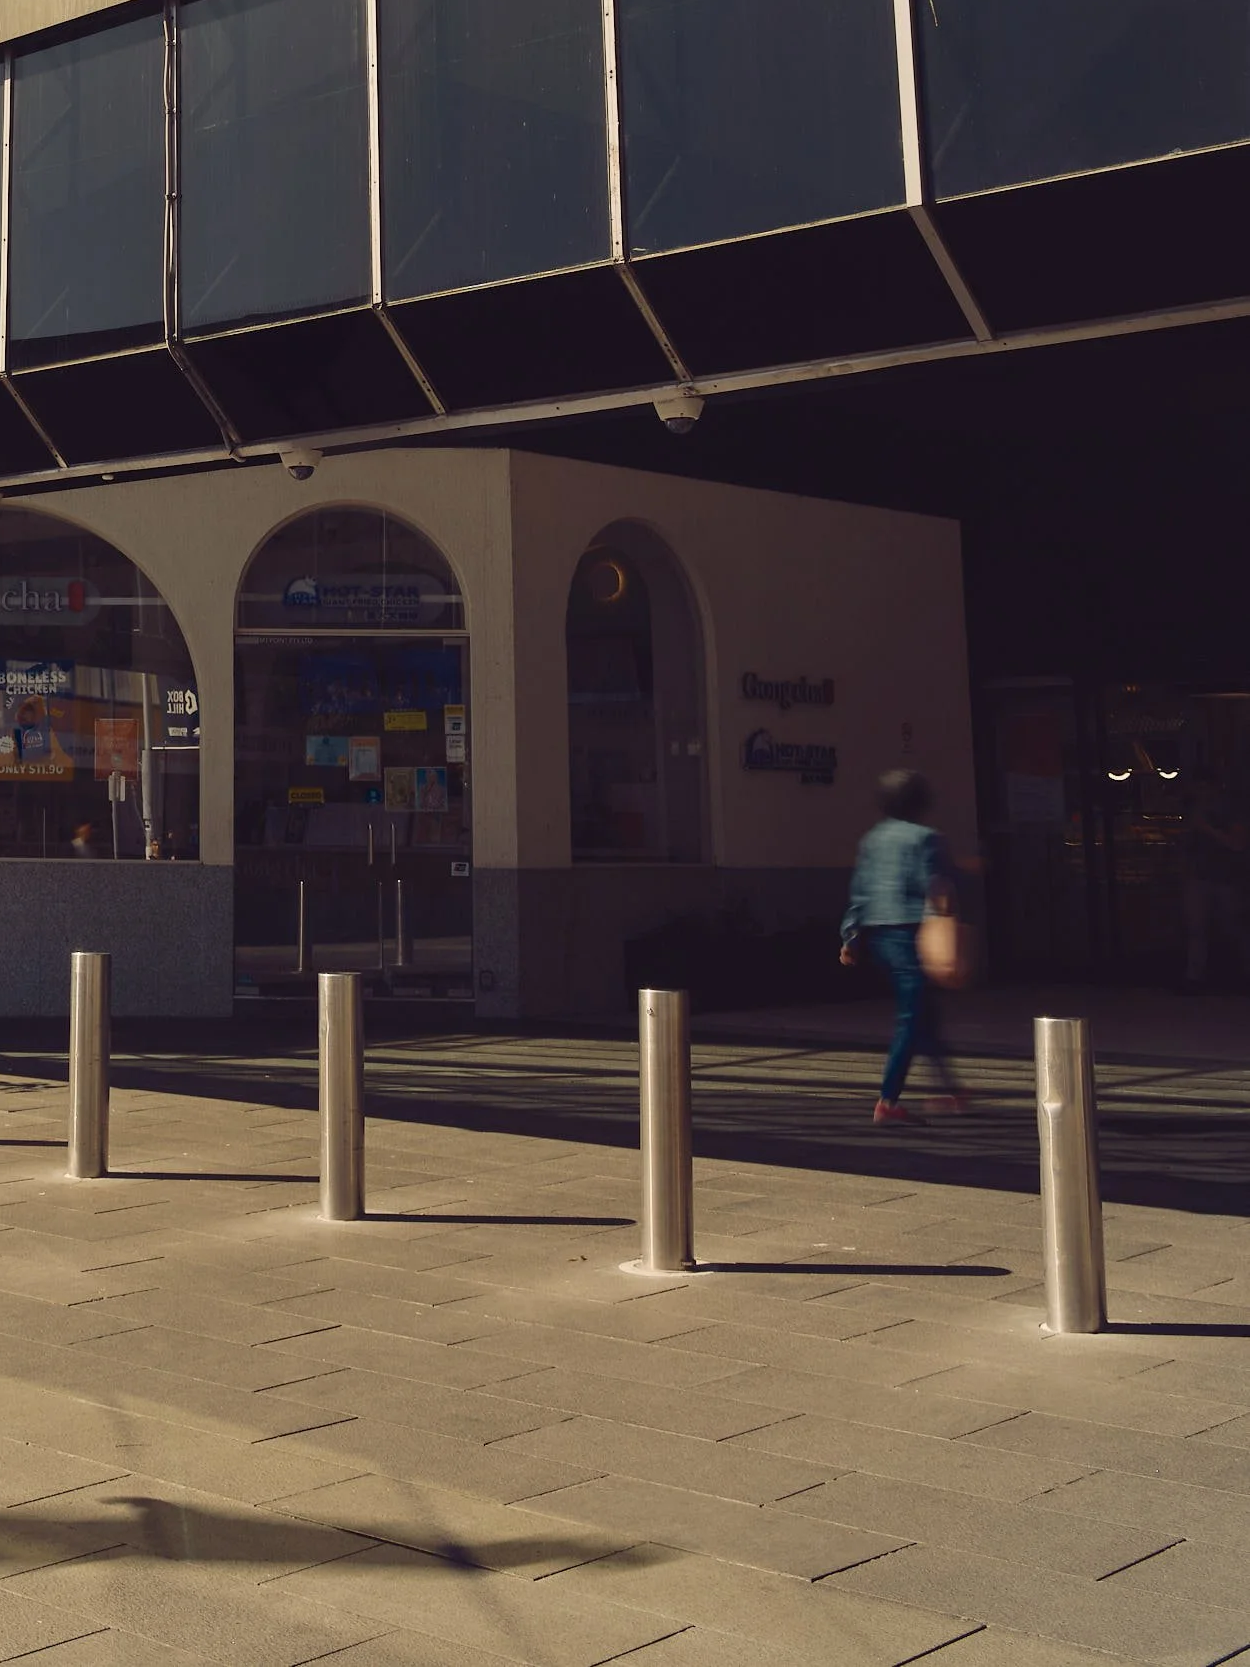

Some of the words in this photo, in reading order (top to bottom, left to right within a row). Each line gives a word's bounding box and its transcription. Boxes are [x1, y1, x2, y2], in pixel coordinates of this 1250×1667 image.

[1, 581, 63, 612] cha
[322, 585, 420, 598] HOT-STAR
[6, 683, 57, 695] CHICKEN
